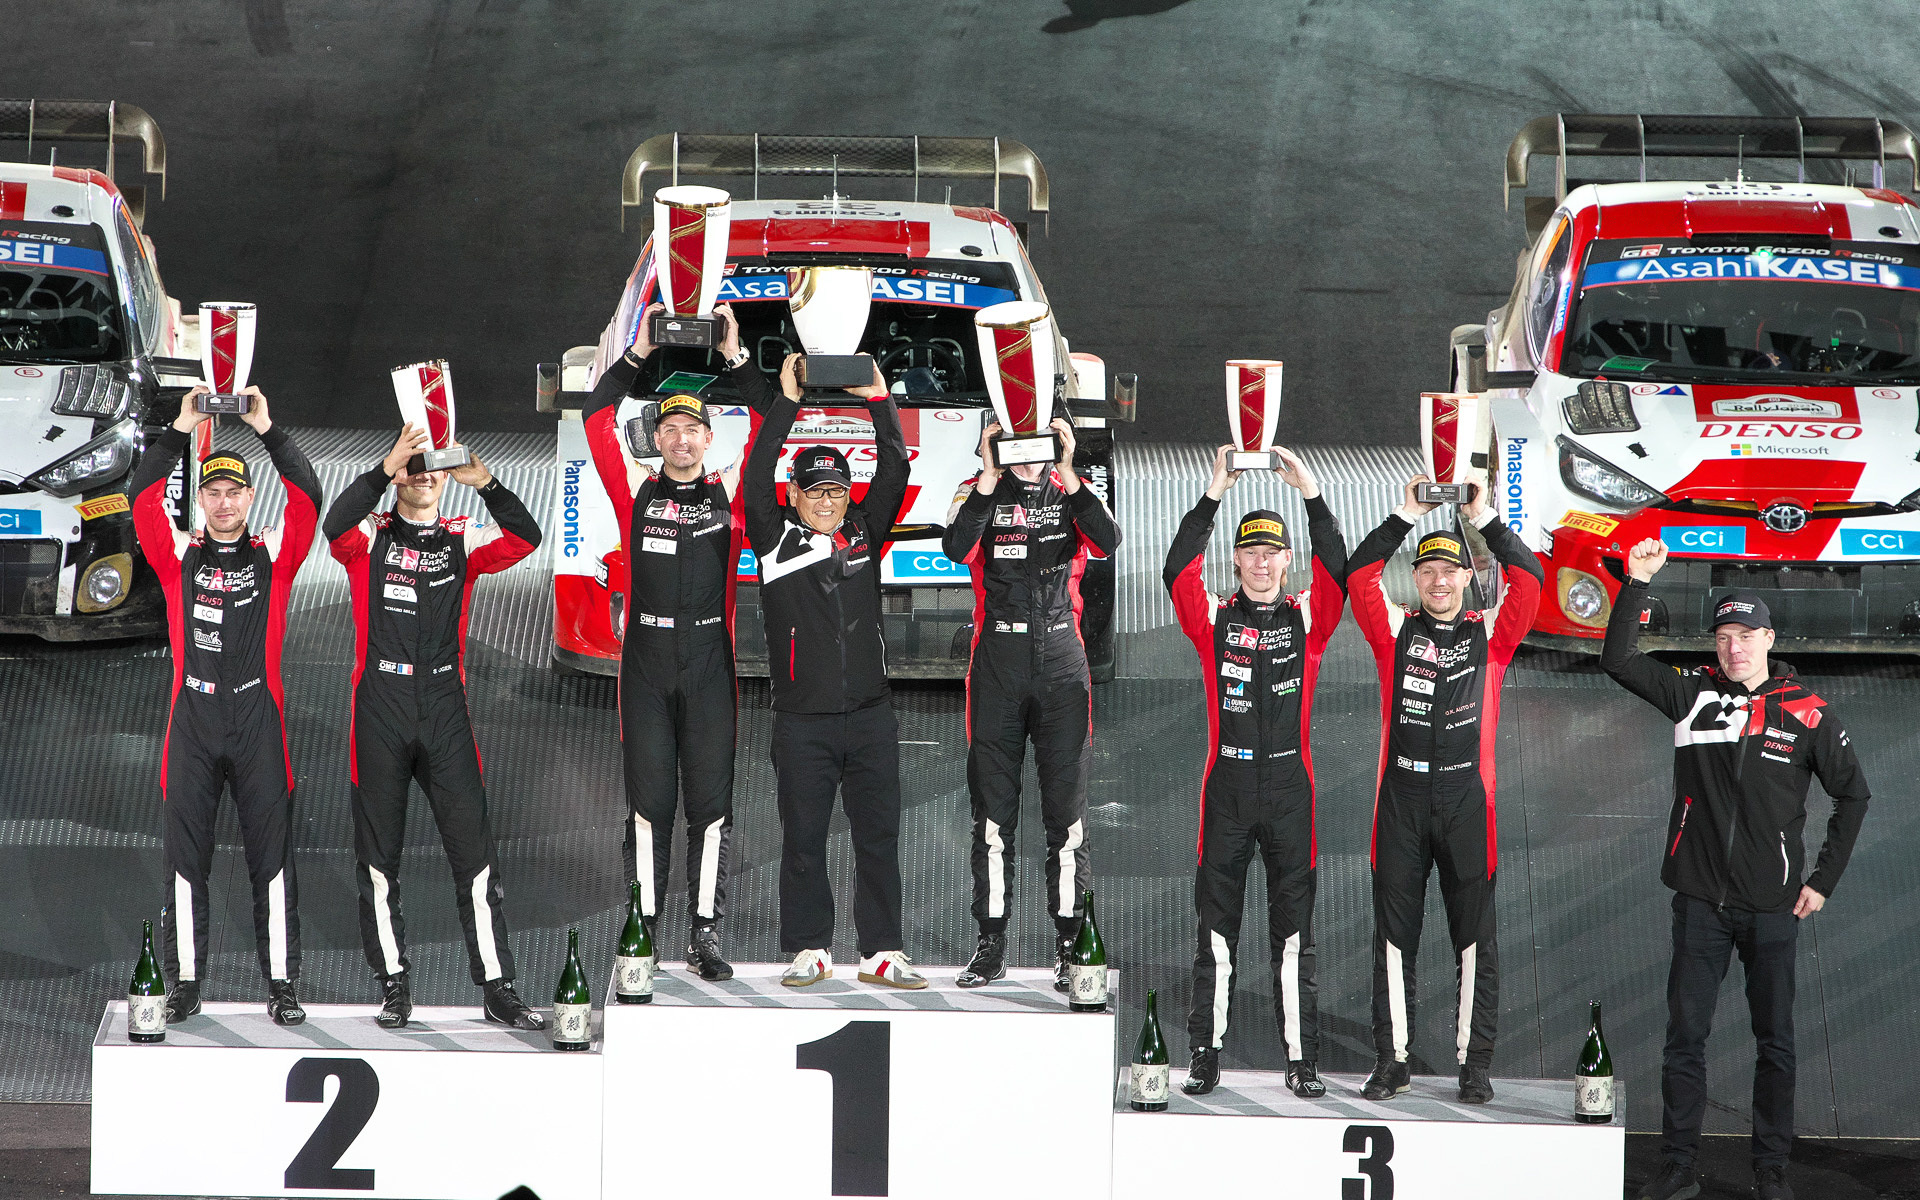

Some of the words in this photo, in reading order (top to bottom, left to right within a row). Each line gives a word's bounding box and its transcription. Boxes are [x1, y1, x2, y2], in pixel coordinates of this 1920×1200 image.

[2, 230, 71, 244] Racing
[1667, 246, 1750, 254] TOYOTA
[1752, 246, 1830, 256] GAZOO
[1834, 250, 1904, 264] Racing
[911, 269, 981, 284] Racing
[1637, 257, 1893, 285] AsahiKASEI
[1700, 424, 1863, 440] DENSO
[1757, 445, 1830, 455] Microsoft
[1507, 437, 1528, 533] Panasonic
[81, 497, 129, 517] PIRELLI
[564, 459, 586, 558] Panasonic
[1562, 512, 1612, 533] PIRELLI
[642, 525, 678, 537] DENSO
[692, 523, 723, 538] Panasonic
[995, 533, 1028, 542] DENSO
[1681, 531, 1724, 546] CCi
[1861, 534, 1904, 549] CCi
[1002, 547, 1020, 556] CCi
[702, 616, 722, 625] MARTIN
[1228, 632, 1256, 650] GR
[1223, 650, 1252, 664] DENSO
[1228, 666, 1244, 678] CCi
[1405, 664, 1437, 679] DENSO
[1402, 697, 1433, 712] UNIBET
[1763, 740, 1794, 753] DENSO
[796, 1021, 890, 1196] 1
[284, 1057, 380, 1190] 2
[1342, 1125, 1395, 1200] 3
